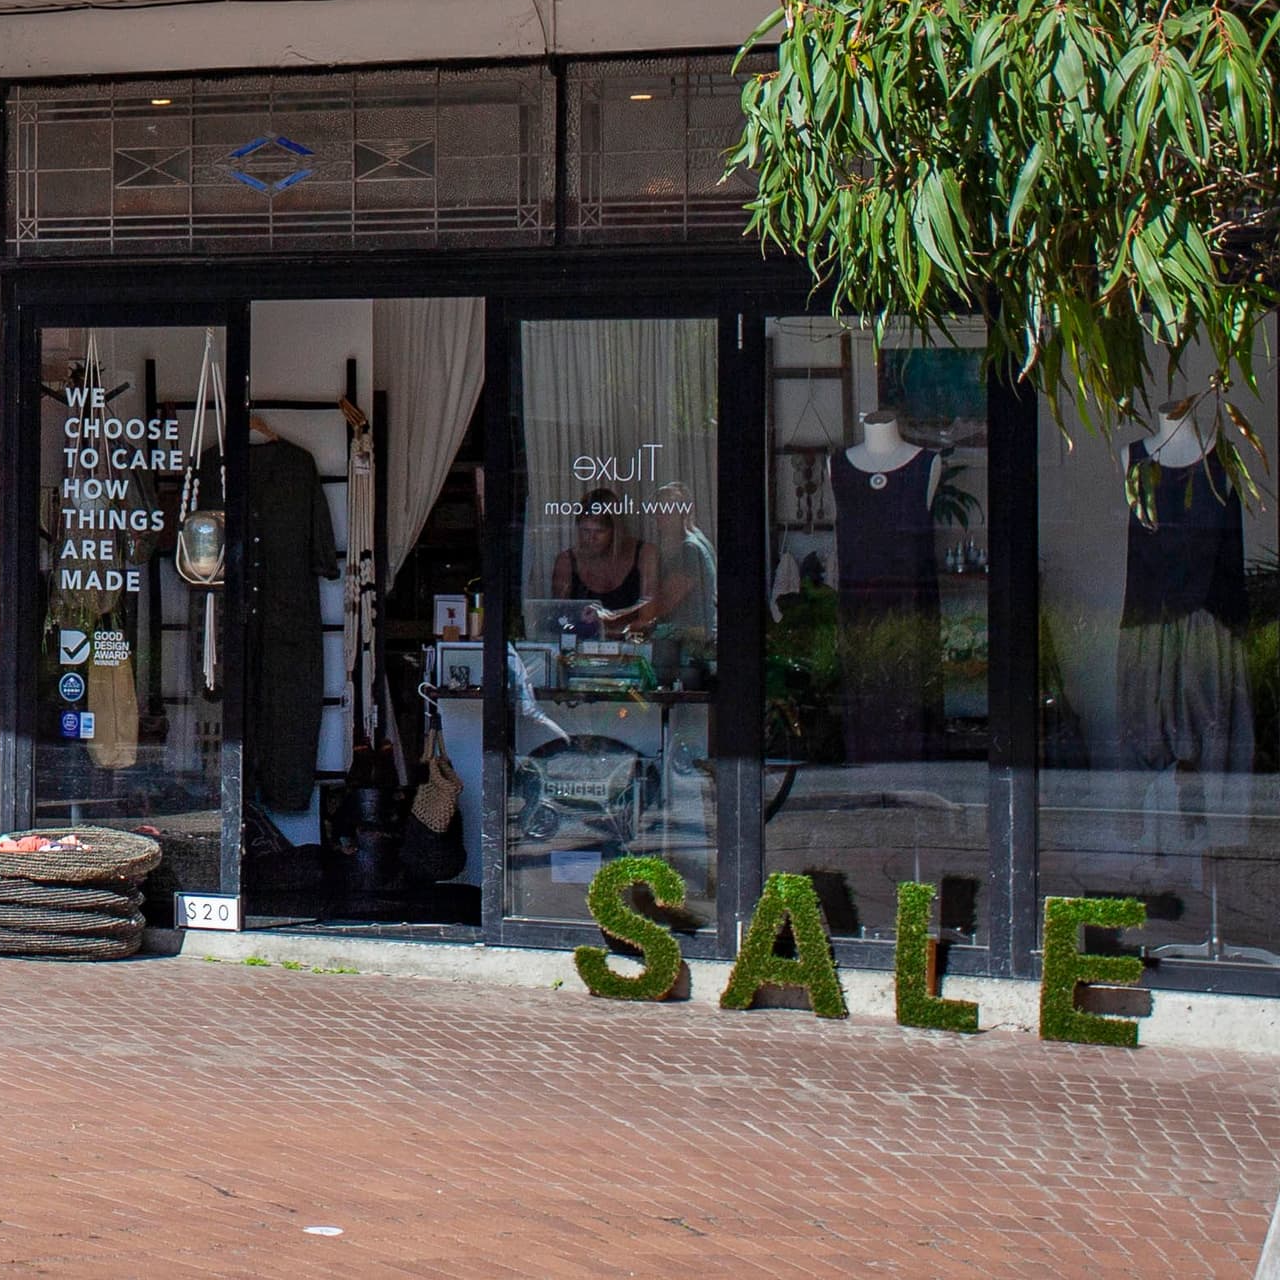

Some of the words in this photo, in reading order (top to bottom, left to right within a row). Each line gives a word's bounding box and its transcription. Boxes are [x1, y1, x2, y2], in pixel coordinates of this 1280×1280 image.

[65, 386, 105, 408] WE
[64, 417, 179, 440] CHOOSE
[63, 447, 99, 469] TO
[111, 448, 183, 470] CARE
[63, 478, 129, 499] HOW
[61, 508, 165, 532] THINGS
[60, 539, 113, 561] ARE
[60, 569, 140, 592] MADE
[94, 631, 123, 641] GOOD
[94, 641, 130, 651] DESIGN
[572, 855, 1148, 1048] SALE
